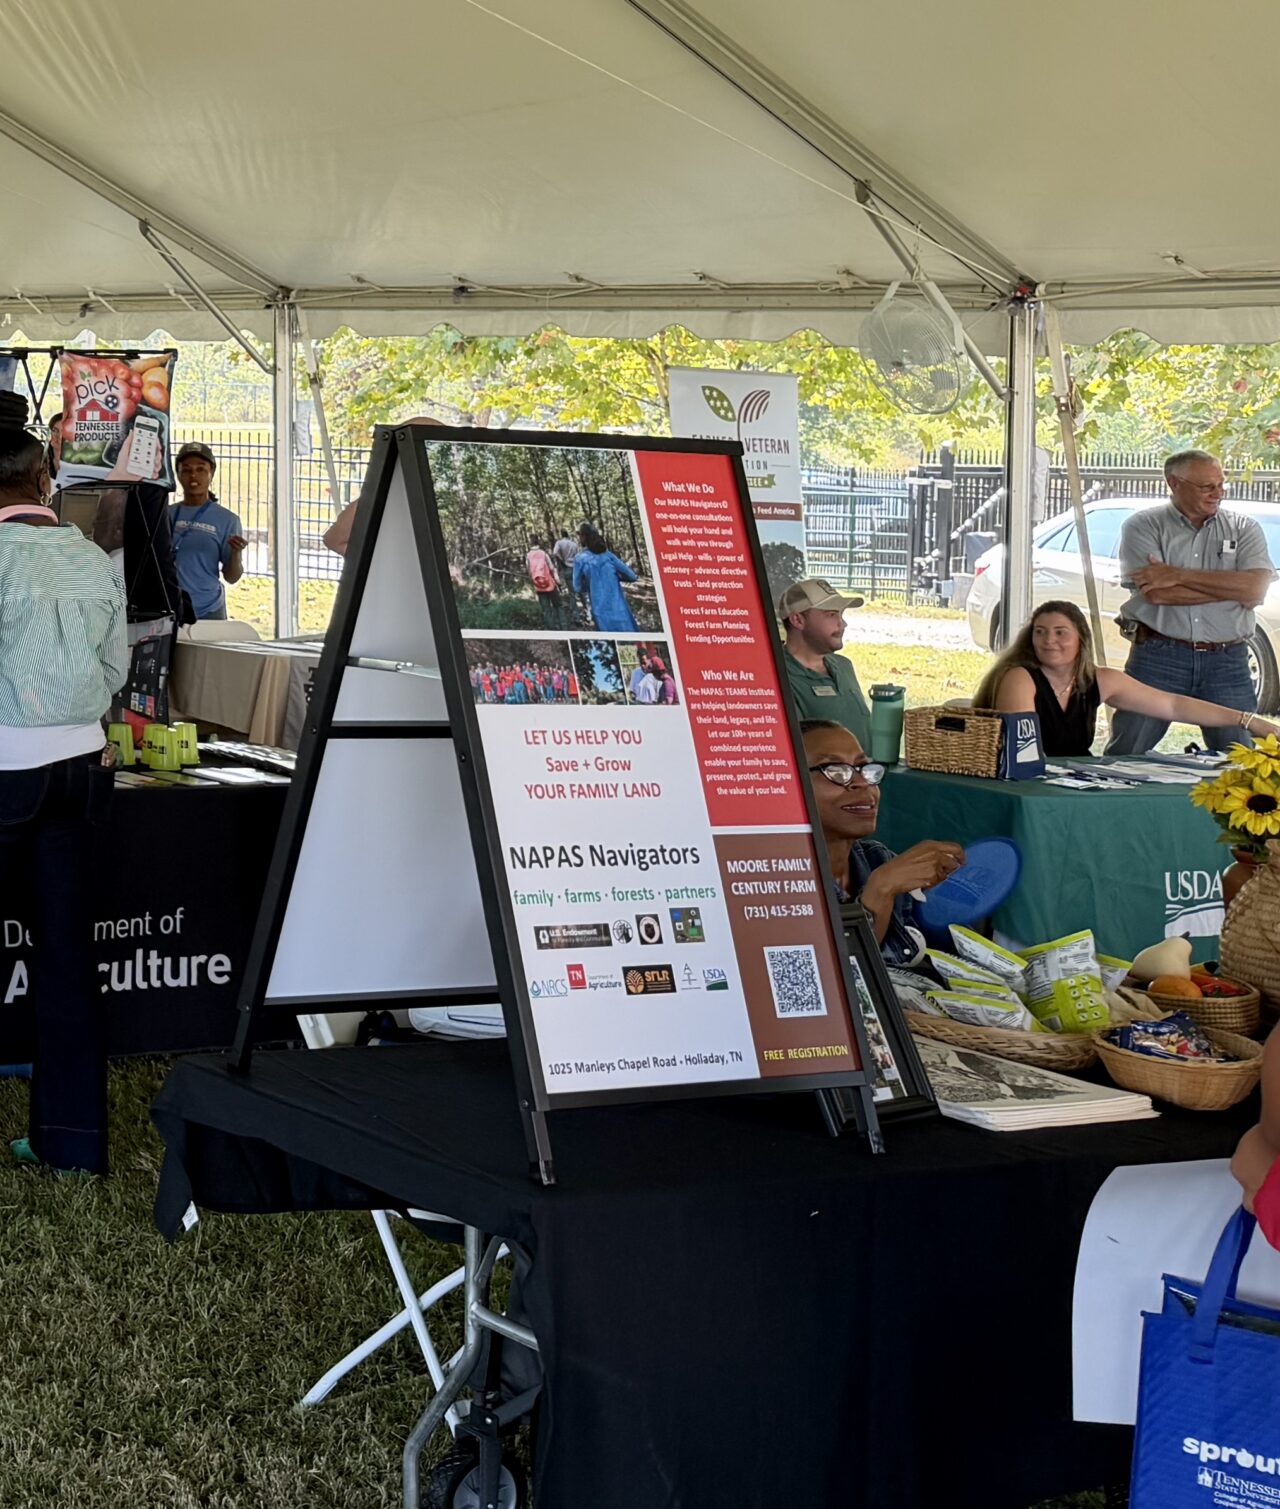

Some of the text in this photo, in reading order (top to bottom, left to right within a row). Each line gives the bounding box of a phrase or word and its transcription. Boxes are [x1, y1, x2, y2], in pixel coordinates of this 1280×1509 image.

[75, 375, 119, 404] pick
[75, 422, 120, 432] TENNESSEE
[75, 432, 120, 442] PRODUCTS
[744, 437, 790, 454] VETERAN
[662, 482, 714, 494] What We Do
[654, 498, 666, 506] Our
[667, 499, 689, 507] NAPAS
[757, 505, 772, 515] Feed
[773, 506, 795, 516] America
[655, 513, 733, 522] one-on-one consultations
[661, 525, 733, 536] will hold your hand and
[666, 539, 733, 549] walk with you through
[661, 552, 744, 563] Legal Help wills power of
[663, 566, 748, 576] attorney advance directive
[673, 580, 743, 590] trusts land protection
[696, 594, 727, 603] strategies
[680, 607, 748, 616] Forest Farm Education
[684, 621, 750, 631] Forest Farm Planning
[685, 635, 755, 644] Funding Opportunities
[701, 670, 754, 680] Who We Are
[687, 687, 775, 696] The NAPAS: TEAMS Institute
[702, 702, 726, 711] helping
[727, 702, 763, 710] landowners
[696, 715, 778, 726] their land, legacy, and life.
[708, 730, 718, 738] Let
[747, 730, 764, 739] years
[765, 729, 772, 737] of
[1017, 718, 1037, 739] USDA
[524, 730, 642, 745] LET US HELP YOU
[710, 743, 776, 753] combined experience
[545, 756, 631, 772] Save + Grow
[704, 758, 726, 766] enable
[727, 760, 741, 768] your
[742, 758, 762, 768] family
[771, 759, 788, 767] save,
[706, 772, 792, 782] preserve, protect, and grow
[524, 782, 661, 799] YOUR FAMILY LAND
[716, 786, 787, 796] the value of your land.
[509, 843, 700, 871] NAPAS Navigators
[727, 858, 812, 873] MOORE FAMILY
[731, 880, 816, 895] CENTURY FARM
[1165, 870, 1224, 901] USDA
[513, 886, 716, 907] family farms forests partners
[744, 904, 814, 920] (731) 415-2588
[159, 907, 185, 935] of
[570, 970, 582, 980] TN
[702, 969, 726, 979] USDA
[541, 979, 568, 995] NRCS
[764, 1045, 848, 1061] FREE REGISTRATION
[549, 1051, 743, 1075] 1025 Manleys Chapel Road Holladay, TN
[1212, 1470, 1280, 1499] TENNESSE
[1239, 1485, 1280, 1505] UNIVERSIT
